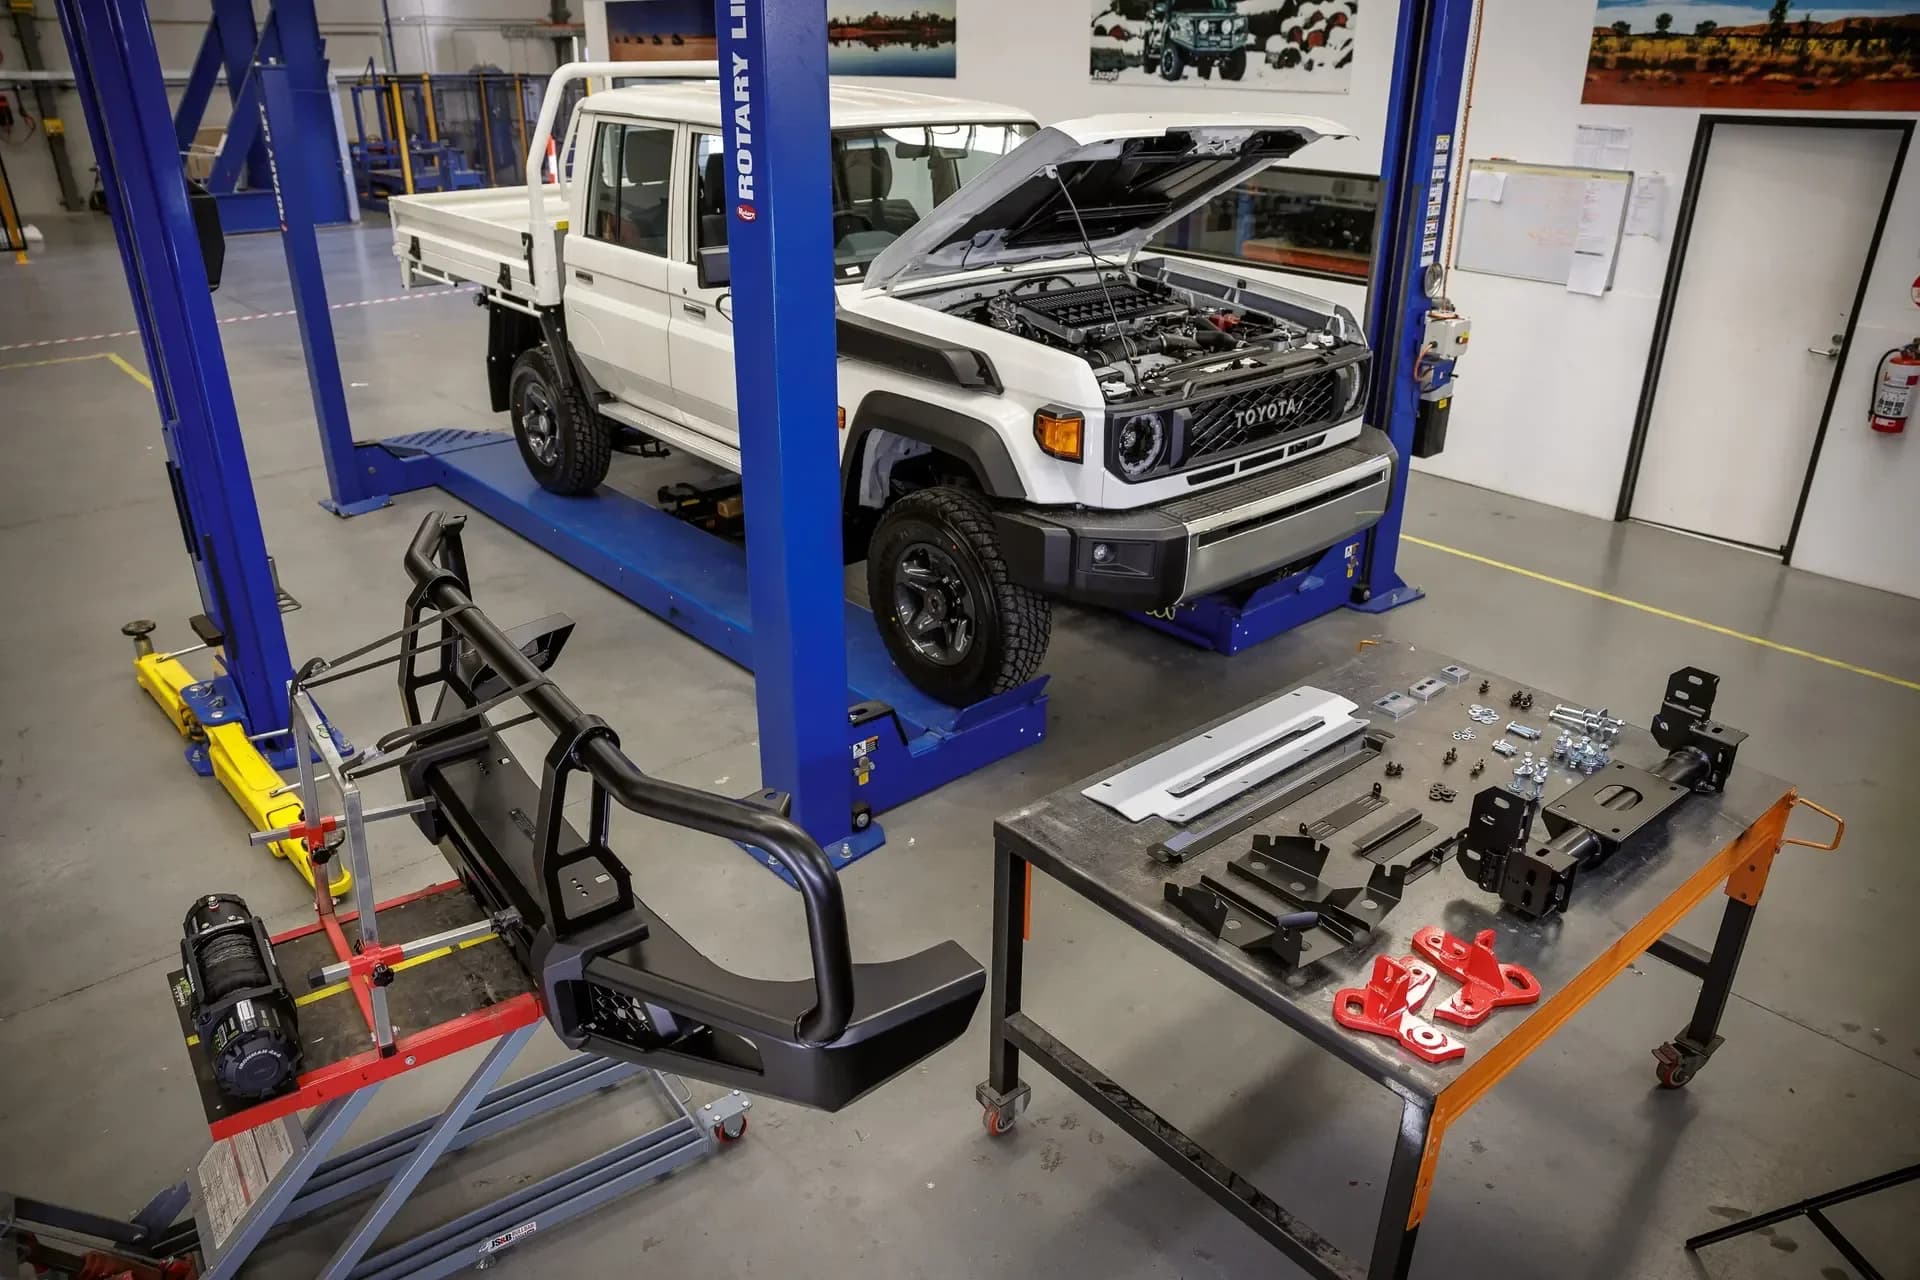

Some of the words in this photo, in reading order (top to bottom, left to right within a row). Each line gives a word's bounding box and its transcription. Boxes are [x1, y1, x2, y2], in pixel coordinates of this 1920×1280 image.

[730, 0, 747, 38] LI
[732, 52, 753, 200] ROTARY
[1235, 399, 1296, 428] TOYOTA
